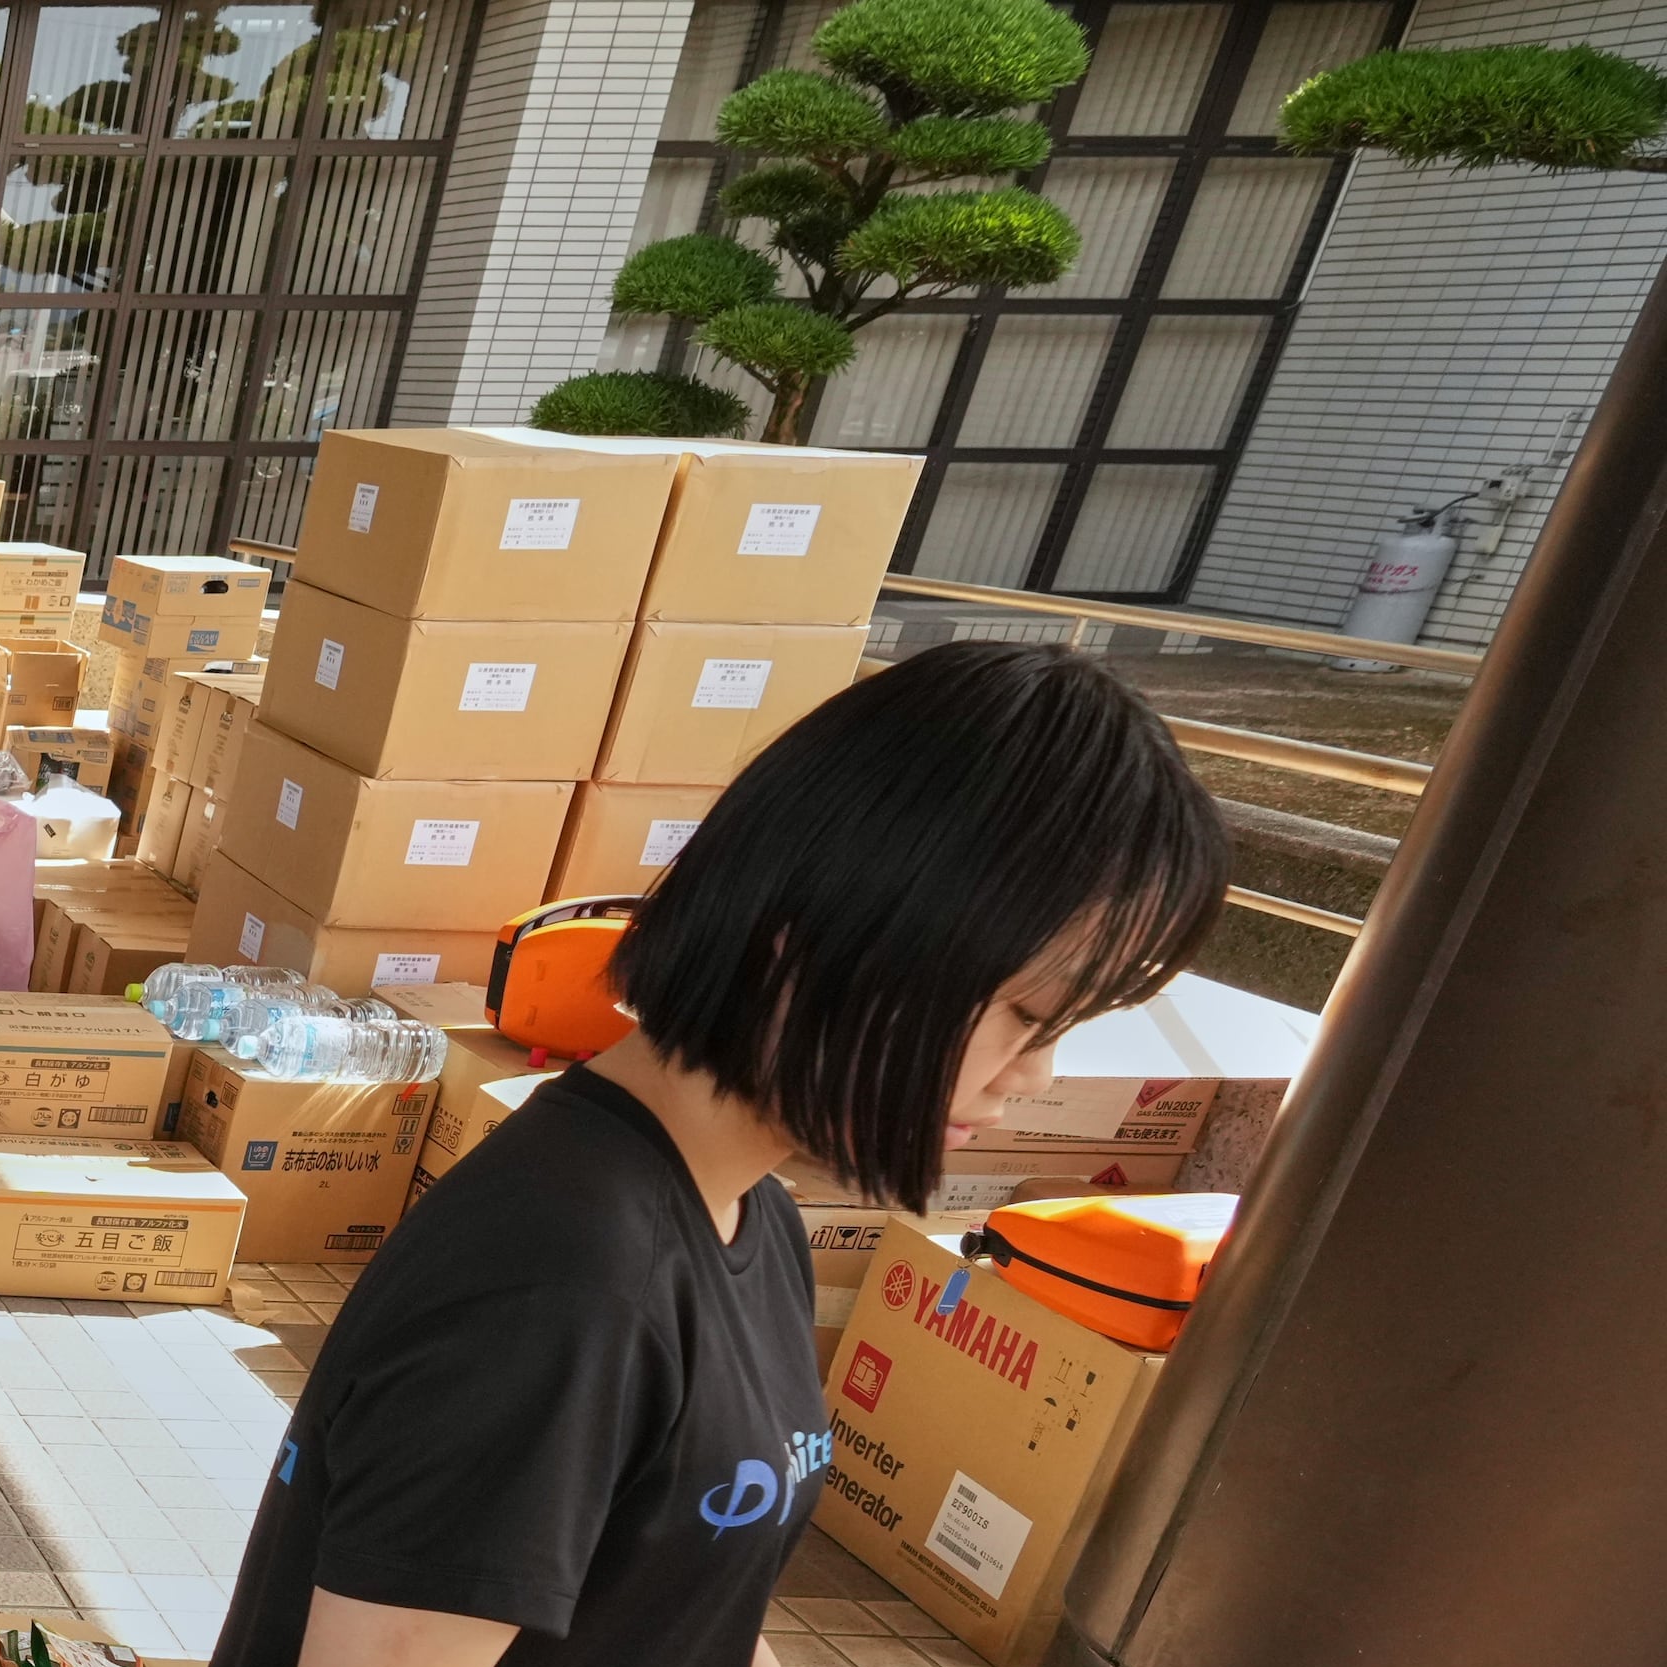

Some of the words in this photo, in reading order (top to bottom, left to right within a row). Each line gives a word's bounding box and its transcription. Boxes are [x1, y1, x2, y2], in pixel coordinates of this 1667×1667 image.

[26, 1072, 90, 1087] 白がゆ
[282, 1150, 381, 1173] 志布志のおいしい水
[319, 1181, 331, 1189] 2L
[75, 1231, 174, 1252] 五目ご飯
[829, 1408, 905, 1481] Inverter
